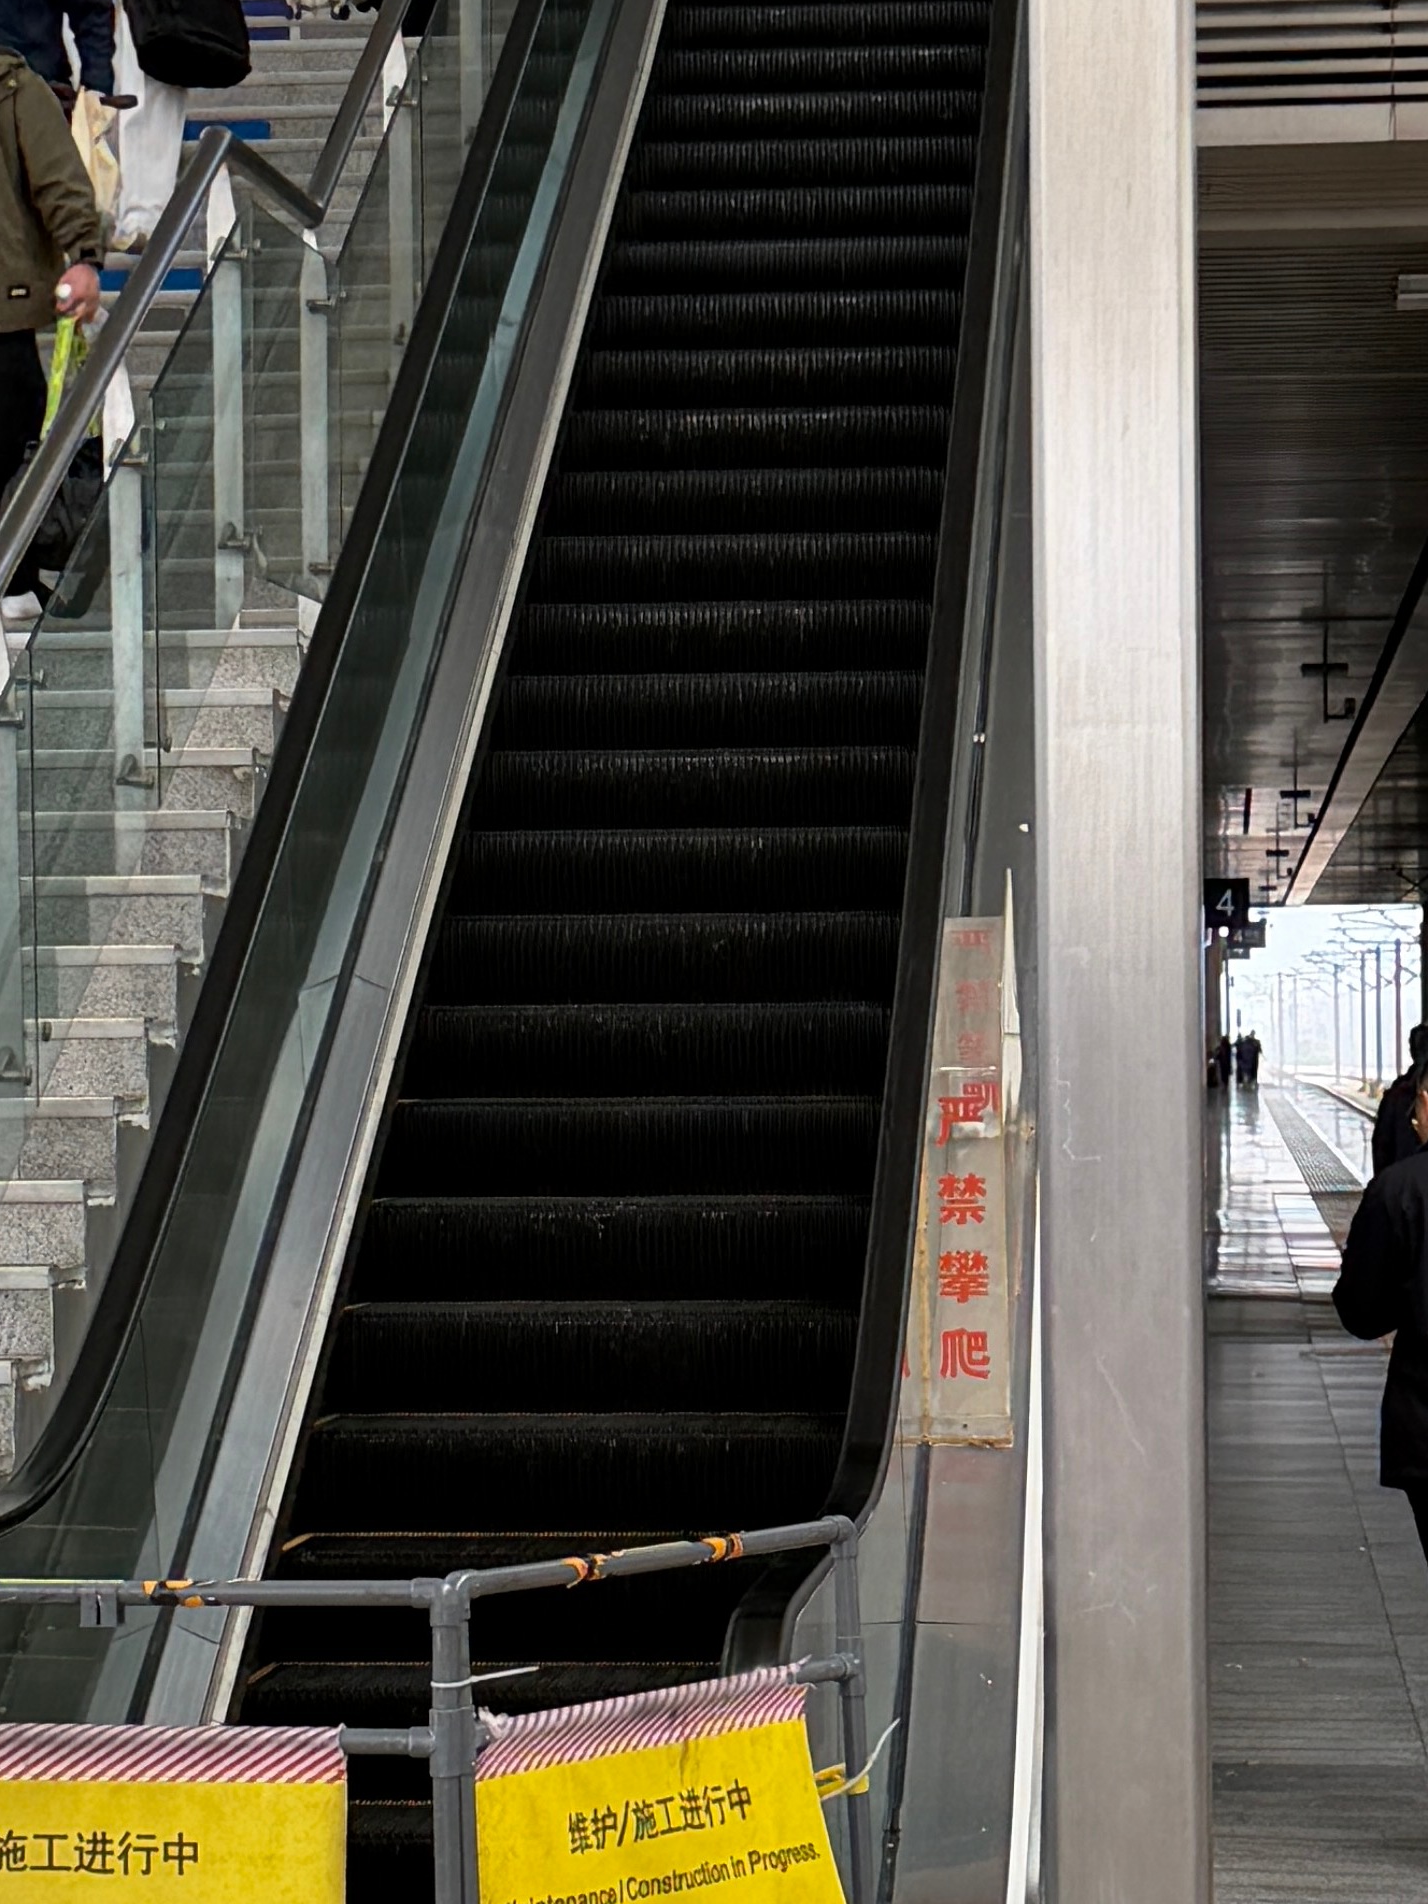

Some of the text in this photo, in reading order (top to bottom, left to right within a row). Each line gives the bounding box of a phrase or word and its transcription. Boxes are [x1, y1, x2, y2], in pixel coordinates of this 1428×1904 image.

[1215, 888, 1234, 916] 4
[934, 1096, 991, 1380] 严禁攀爬
[567, 1779, 752, 1855] 维护/施工进行中
[626, 1860, 730, 1902] Construction
[732, 1856, 747, 1879] in
[748, 1842, 821, 1876] Progress.
